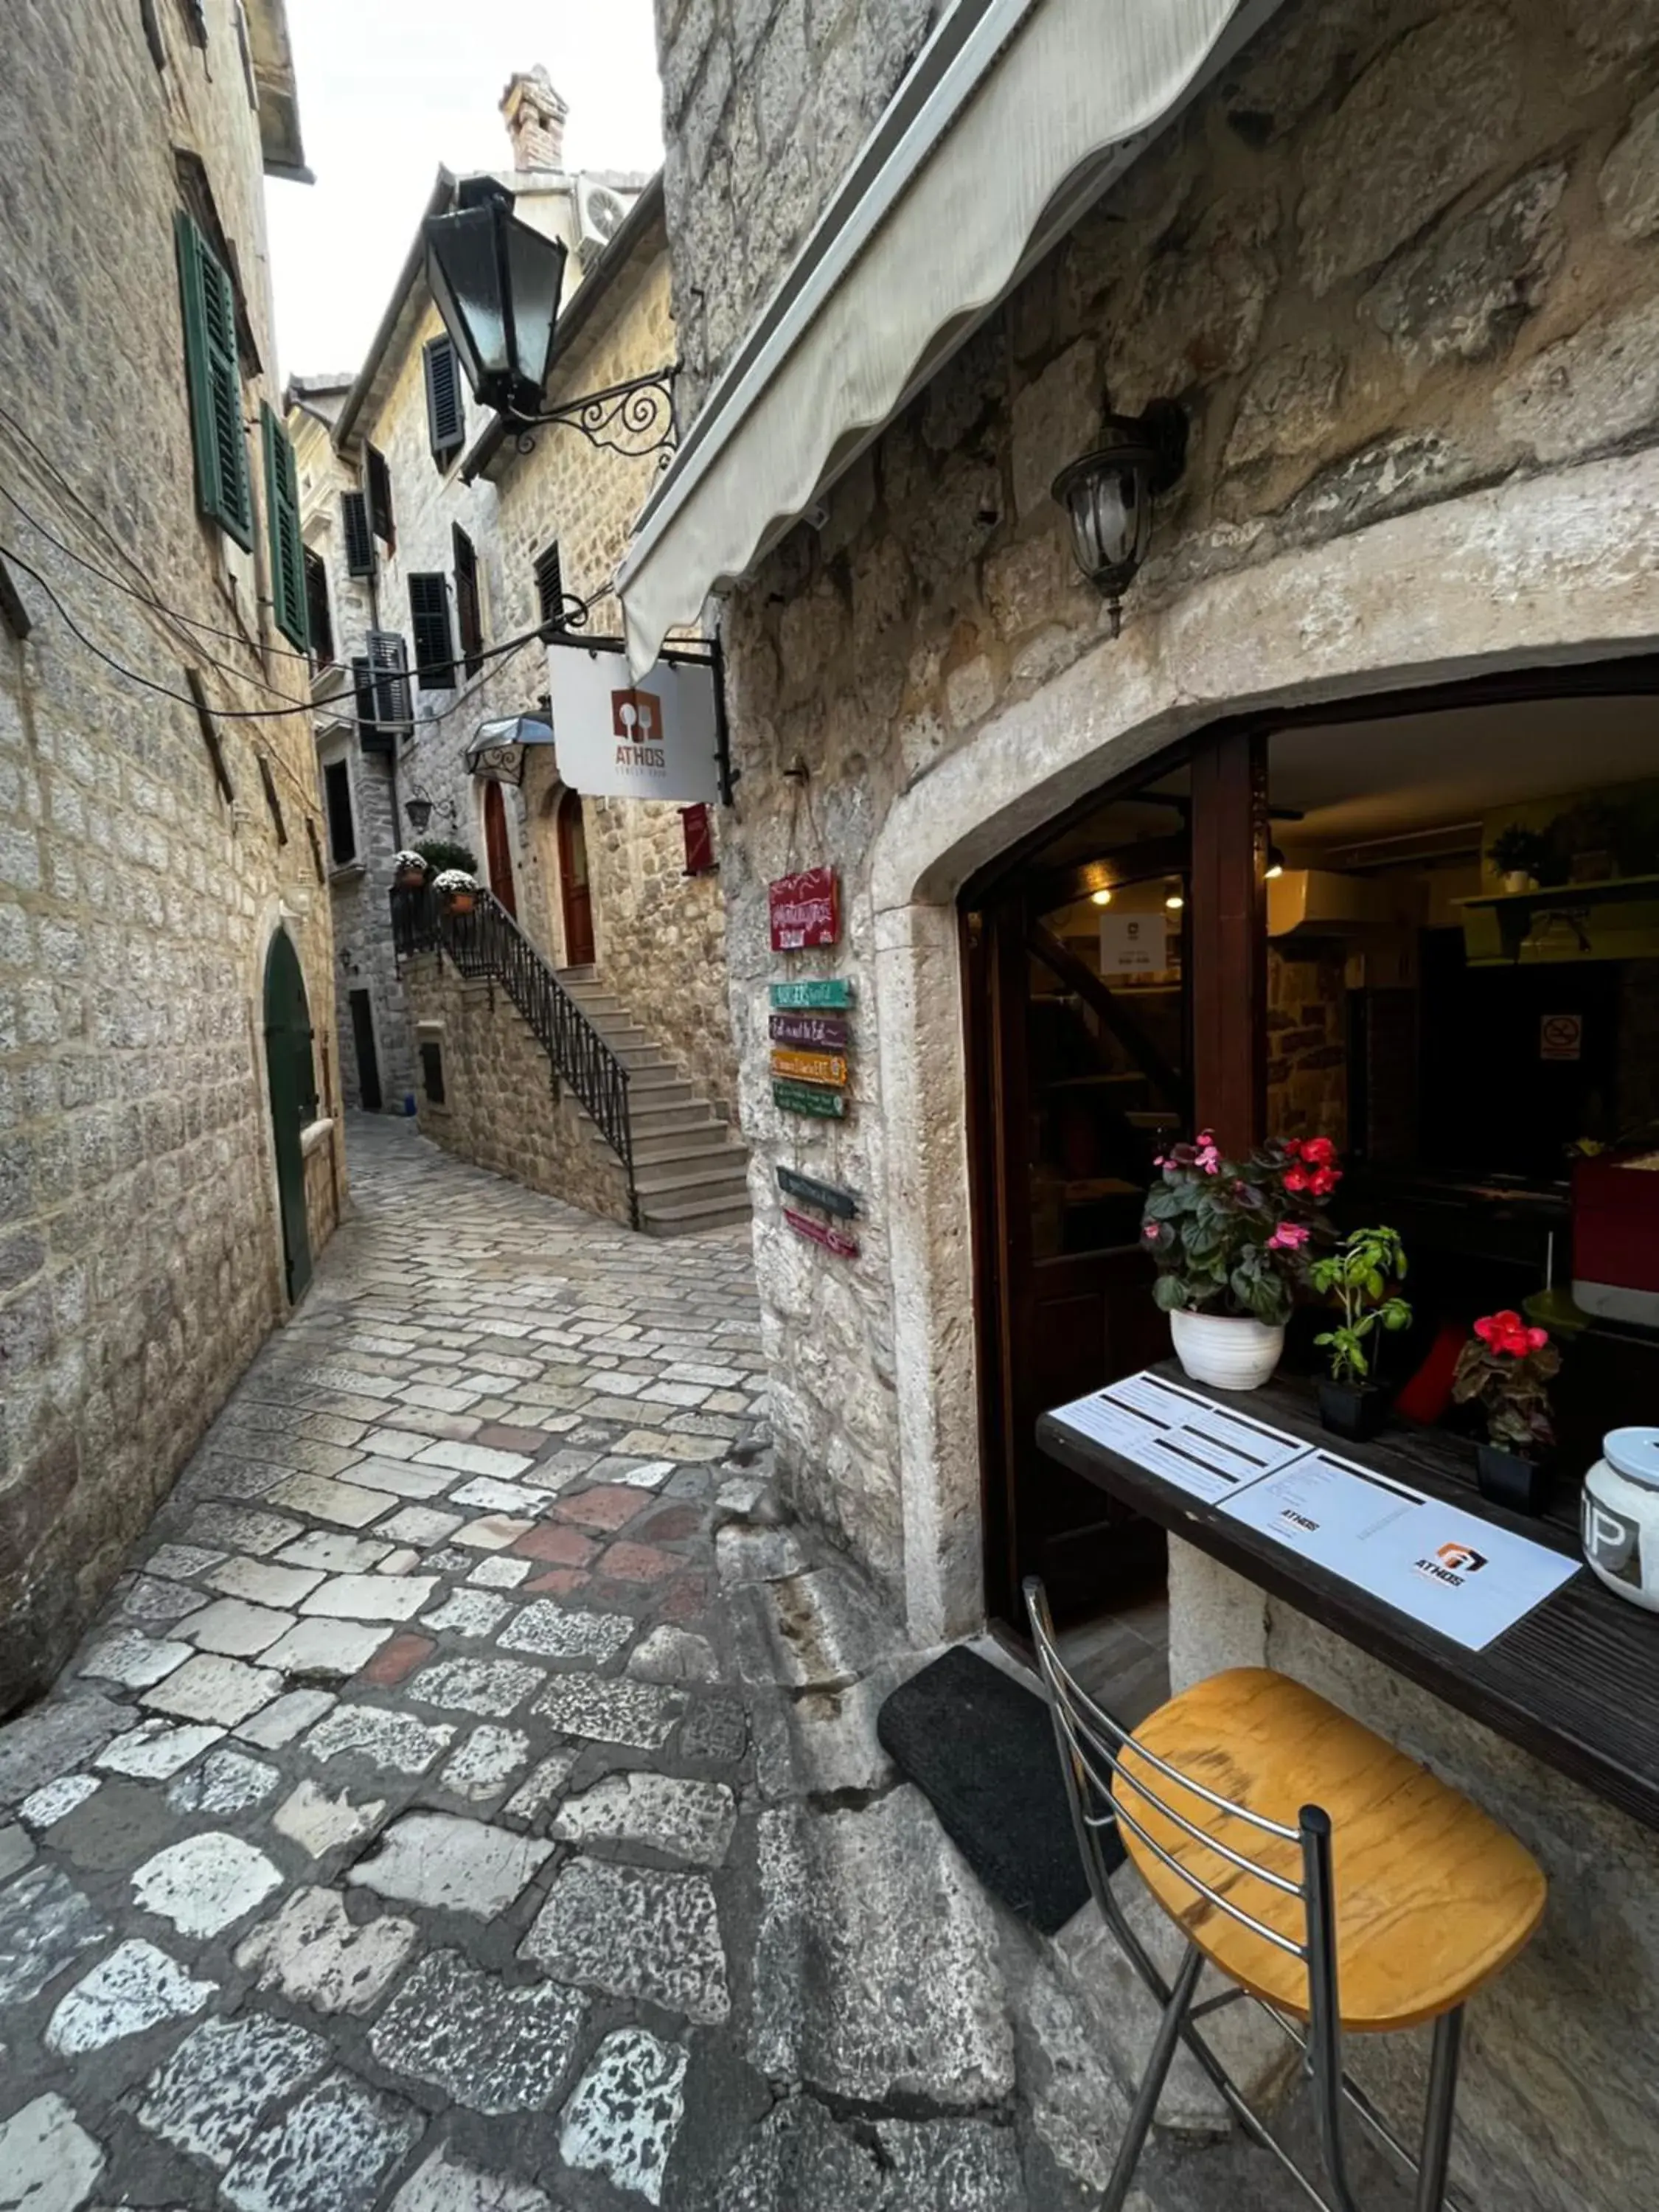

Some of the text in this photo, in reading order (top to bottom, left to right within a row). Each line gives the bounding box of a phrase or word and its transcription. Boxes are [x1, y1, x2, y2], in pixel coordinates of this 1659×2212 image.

[616, 745, 665, 768] ATHOS
[1281, 1509, 1320, 1531] ATHOS
[1415, 1559, 1465, 1586] ATHOS
